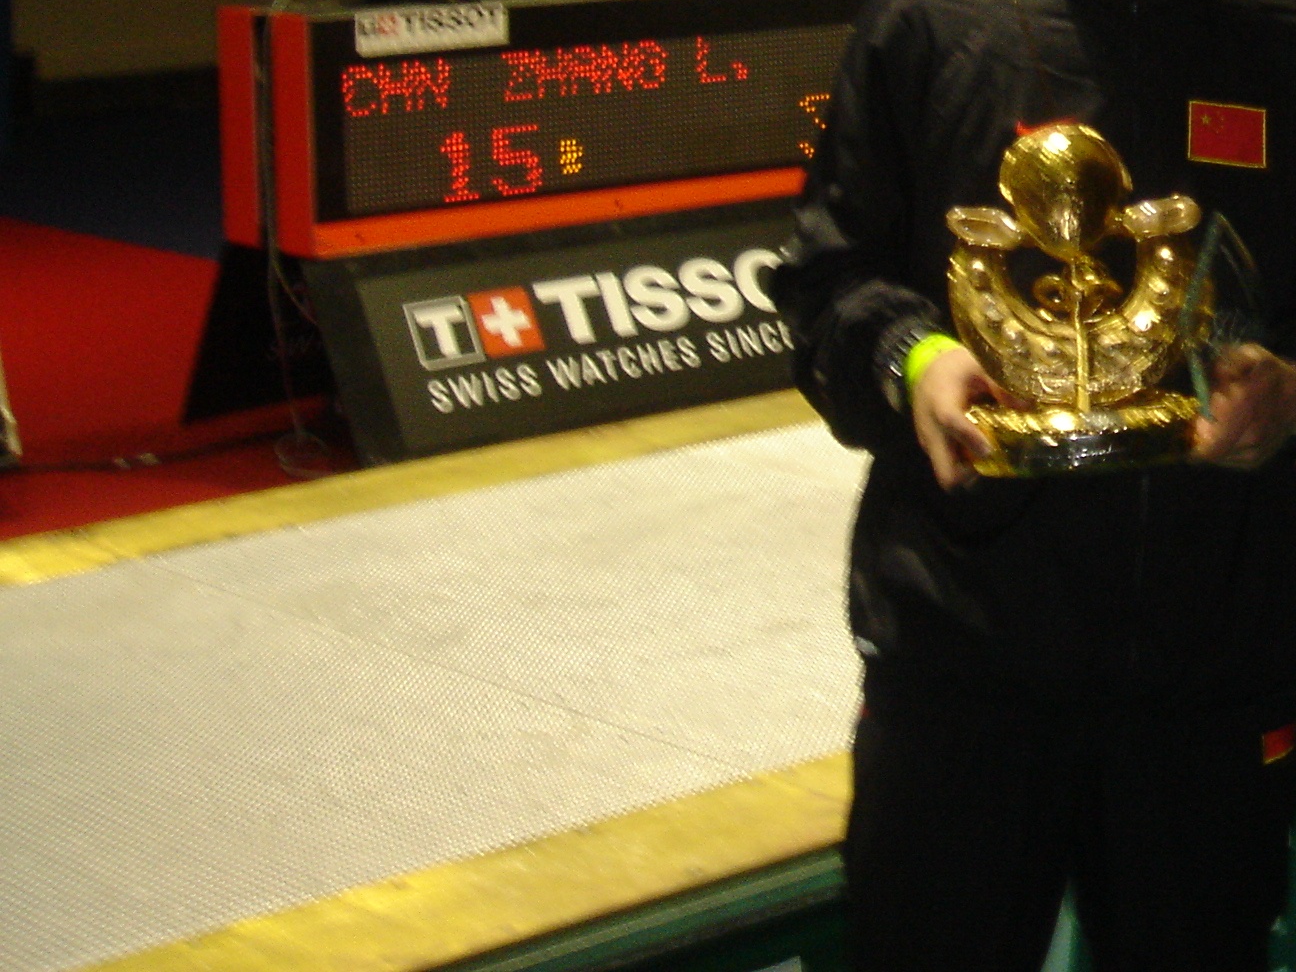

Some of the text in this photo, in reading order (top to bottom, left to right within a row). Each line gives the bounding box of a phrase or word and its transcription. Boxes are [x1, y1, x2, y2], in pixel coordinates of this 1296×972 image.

[440, 124, 543, 203] 15
[531, 247, 788, 344] TISSO
[426, 367, 543, 414] SWISS
[546, 331, 701, 392] WATCHES
